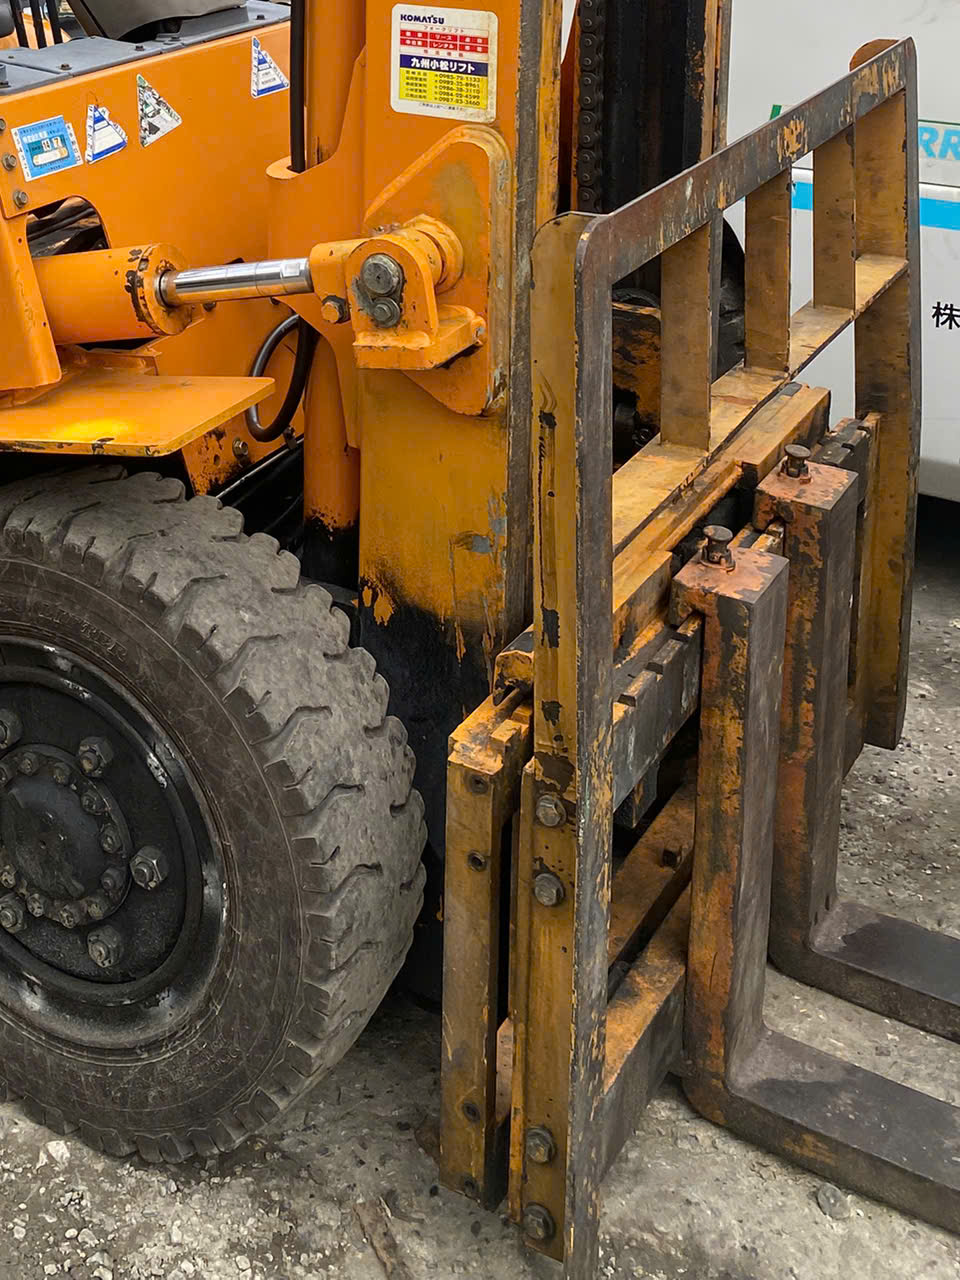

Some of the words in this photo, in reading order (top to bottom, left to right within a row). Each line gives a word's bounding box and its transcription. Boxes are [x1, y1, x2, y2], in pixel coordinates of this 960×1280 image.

[400, 13, 445, 25] KOMATSU
[410, 57, 475, 74] 九州小松リフト
